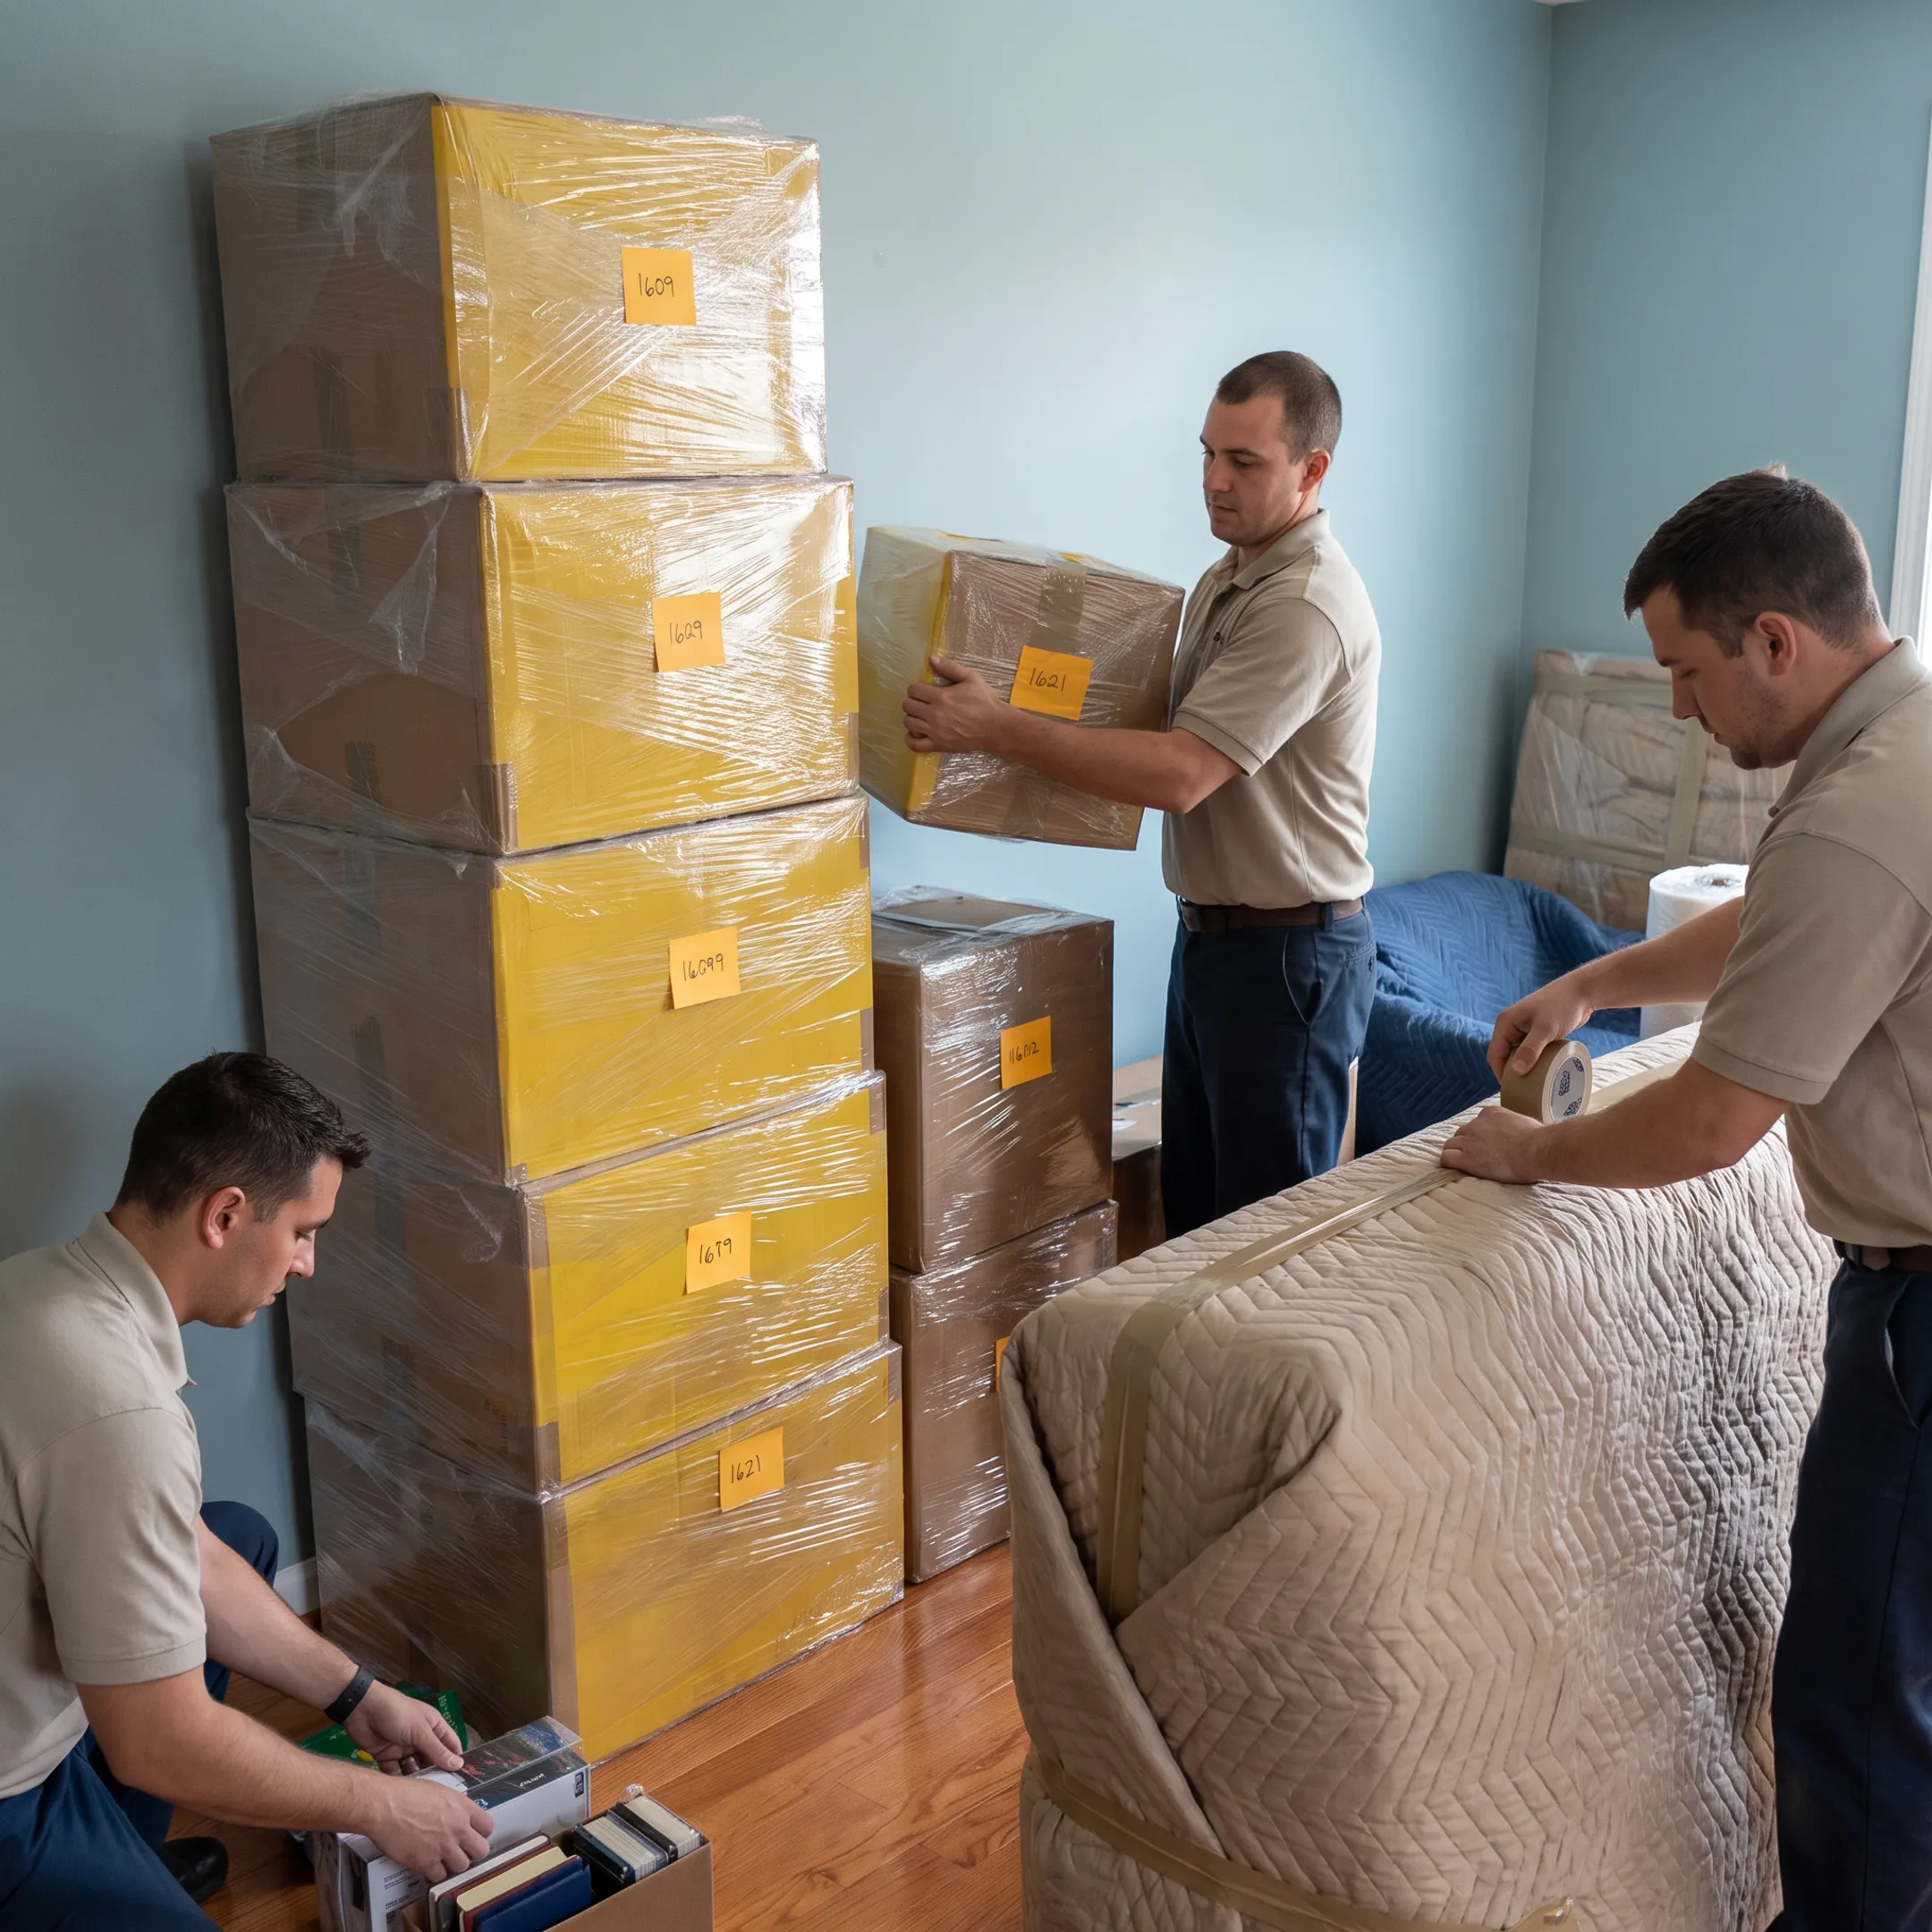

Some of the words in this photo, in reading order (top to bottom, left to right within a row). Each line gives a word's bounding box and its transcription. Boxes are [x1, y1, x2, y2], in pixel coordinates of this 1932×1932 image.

[639, 273, 674, 297] 1609
[1029, 667, 1066, 692] 1621
[731, 1454, 761, 1484] 1621
